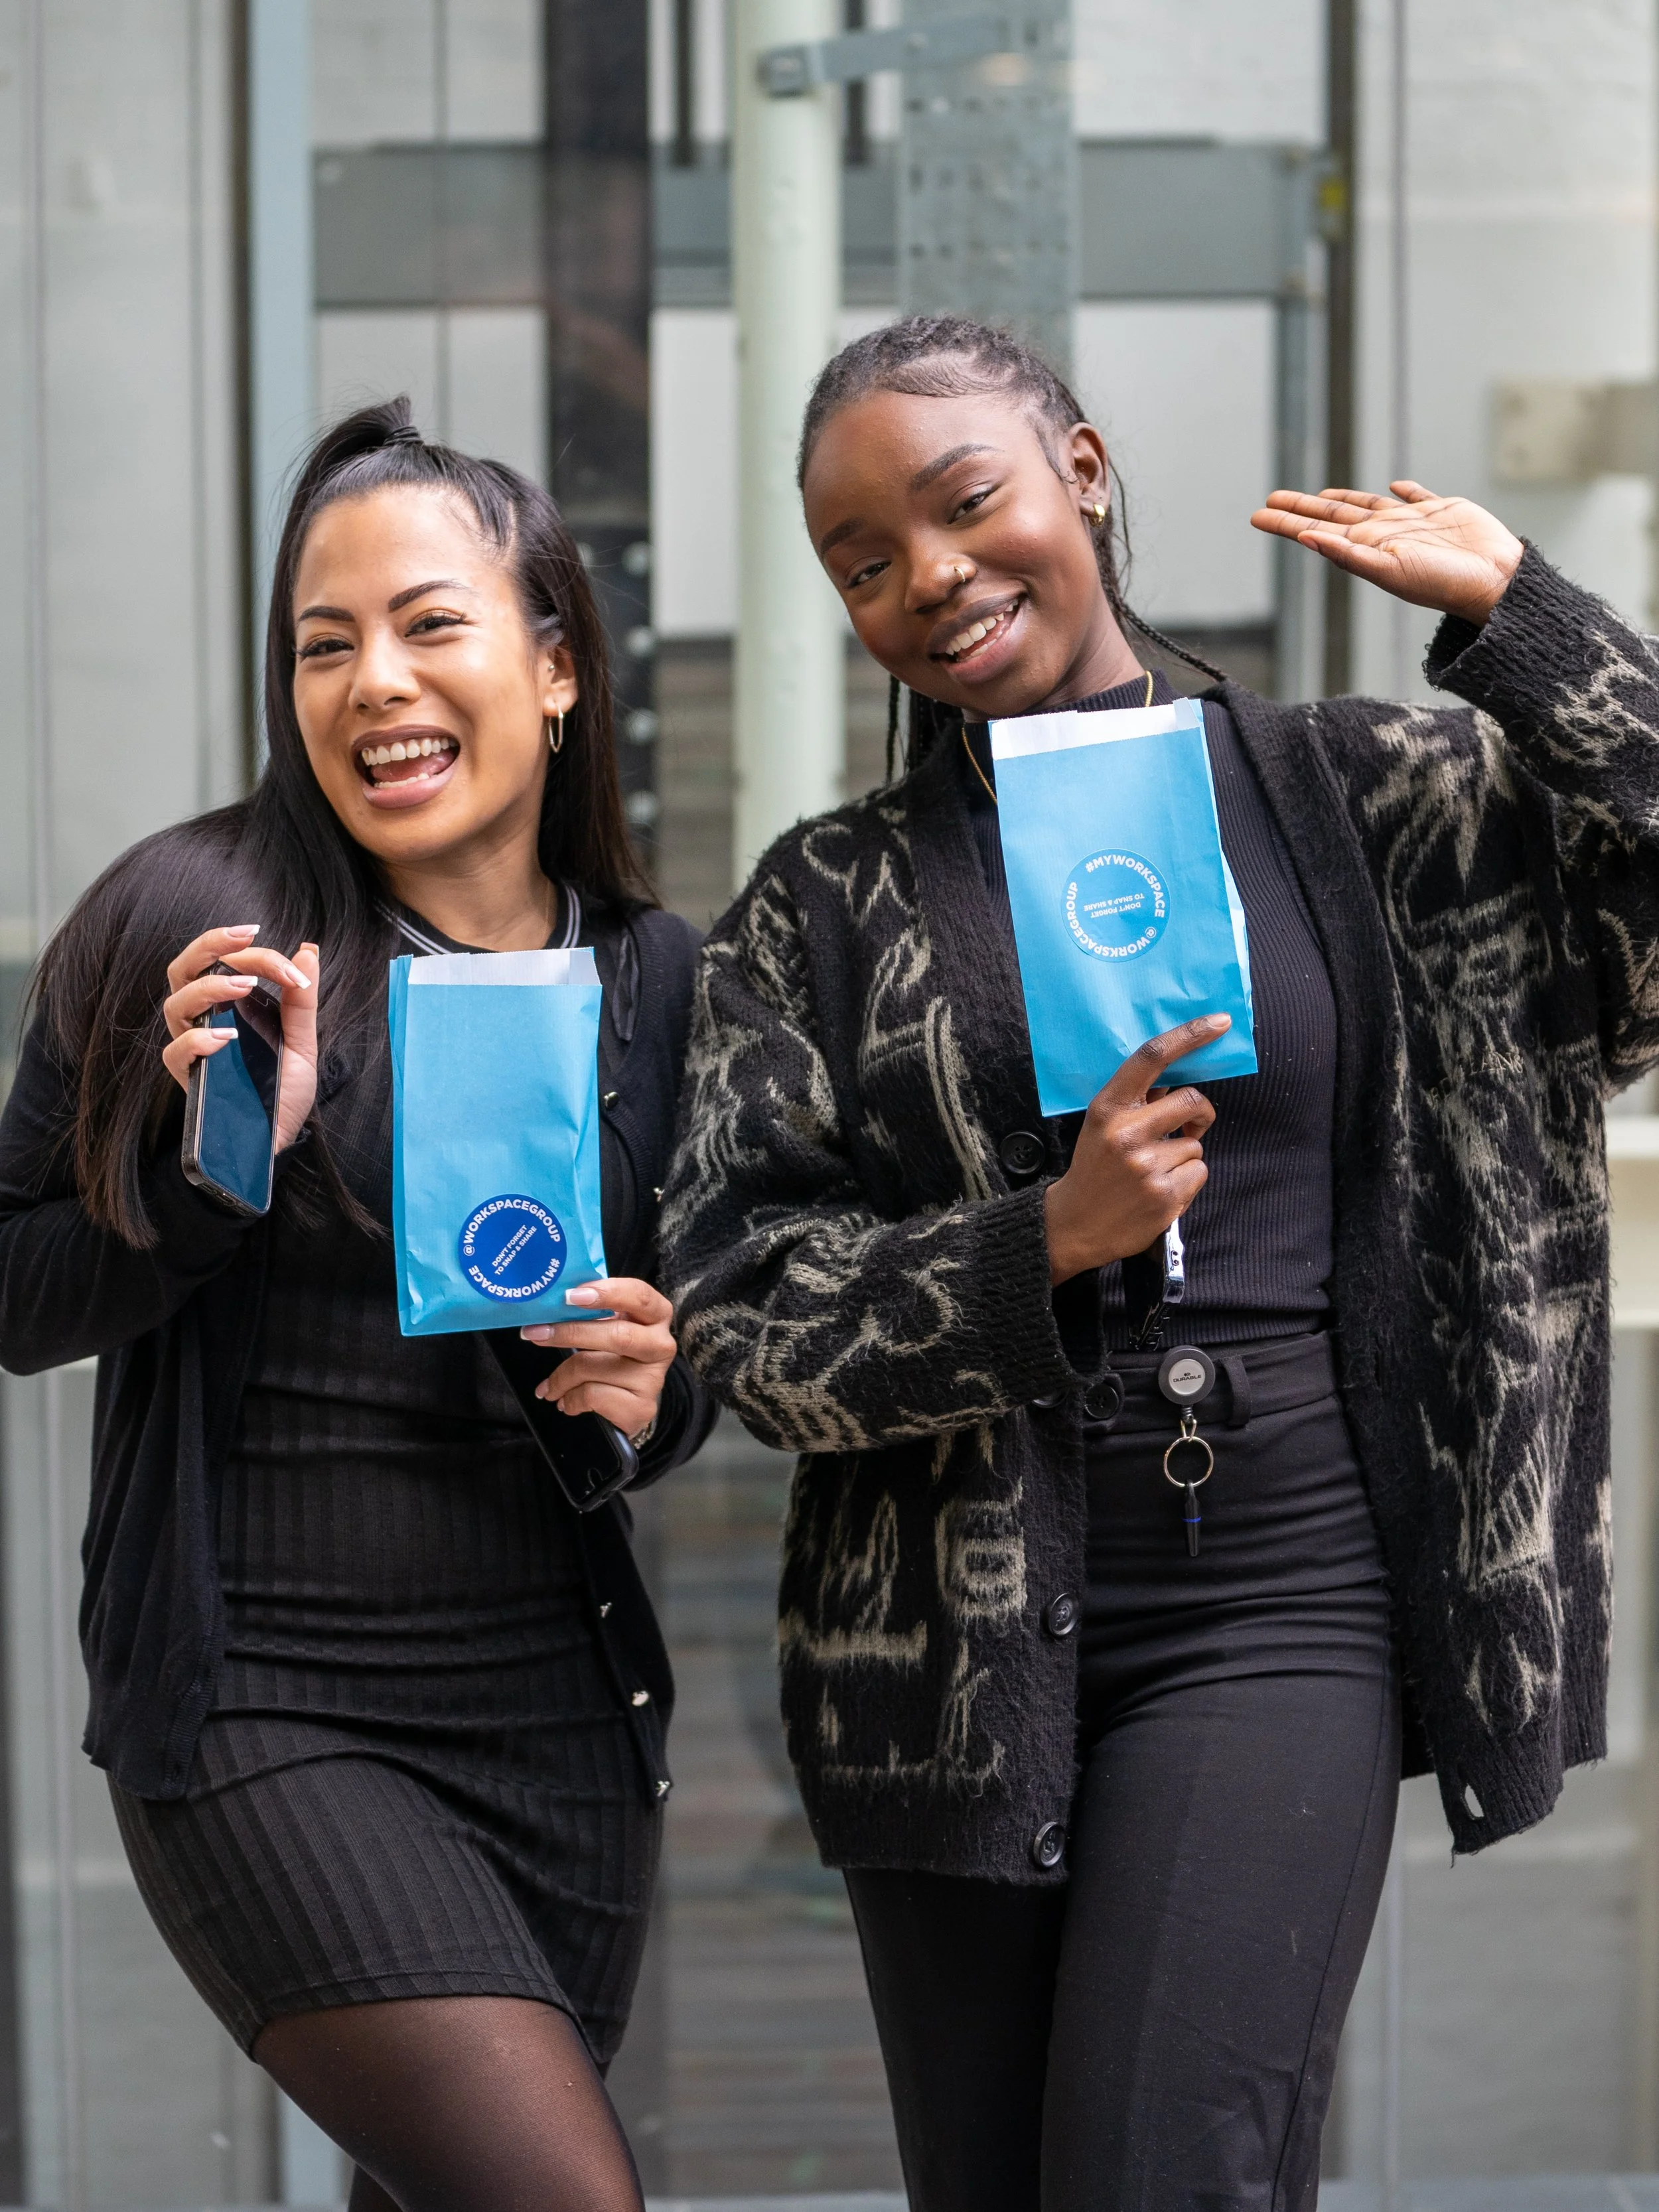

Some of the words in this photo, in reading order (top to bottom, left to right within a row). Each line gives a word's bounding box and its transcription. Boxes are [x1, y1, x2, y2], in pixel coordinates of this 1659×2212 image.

[1084, 855, 1165, 918] #MYWORKSPACE
[1084, 902, 1107, 911] SHARE
[1114, 895, 1133, 904] SNAP
[1119, 902, 1141, 912] DON'T
[1066, 882, 1157, 957] @WORKSPACEGROUP
[1090, 908, 1118, 918] FORGET
[463, 1199, 561, 1257] @WORKSPACEGROUP
[492, 1248, 510, 1267] DON'T
[507, 1225, 527, 1249] FORGET
[494, 1267, 504, 1275] TO
[503, 1251, 516, 1267] SNAP
[520, 1226, 536, 1245] SHARE
[468, 1258, 560, 1298] #MYWORKSPACE
